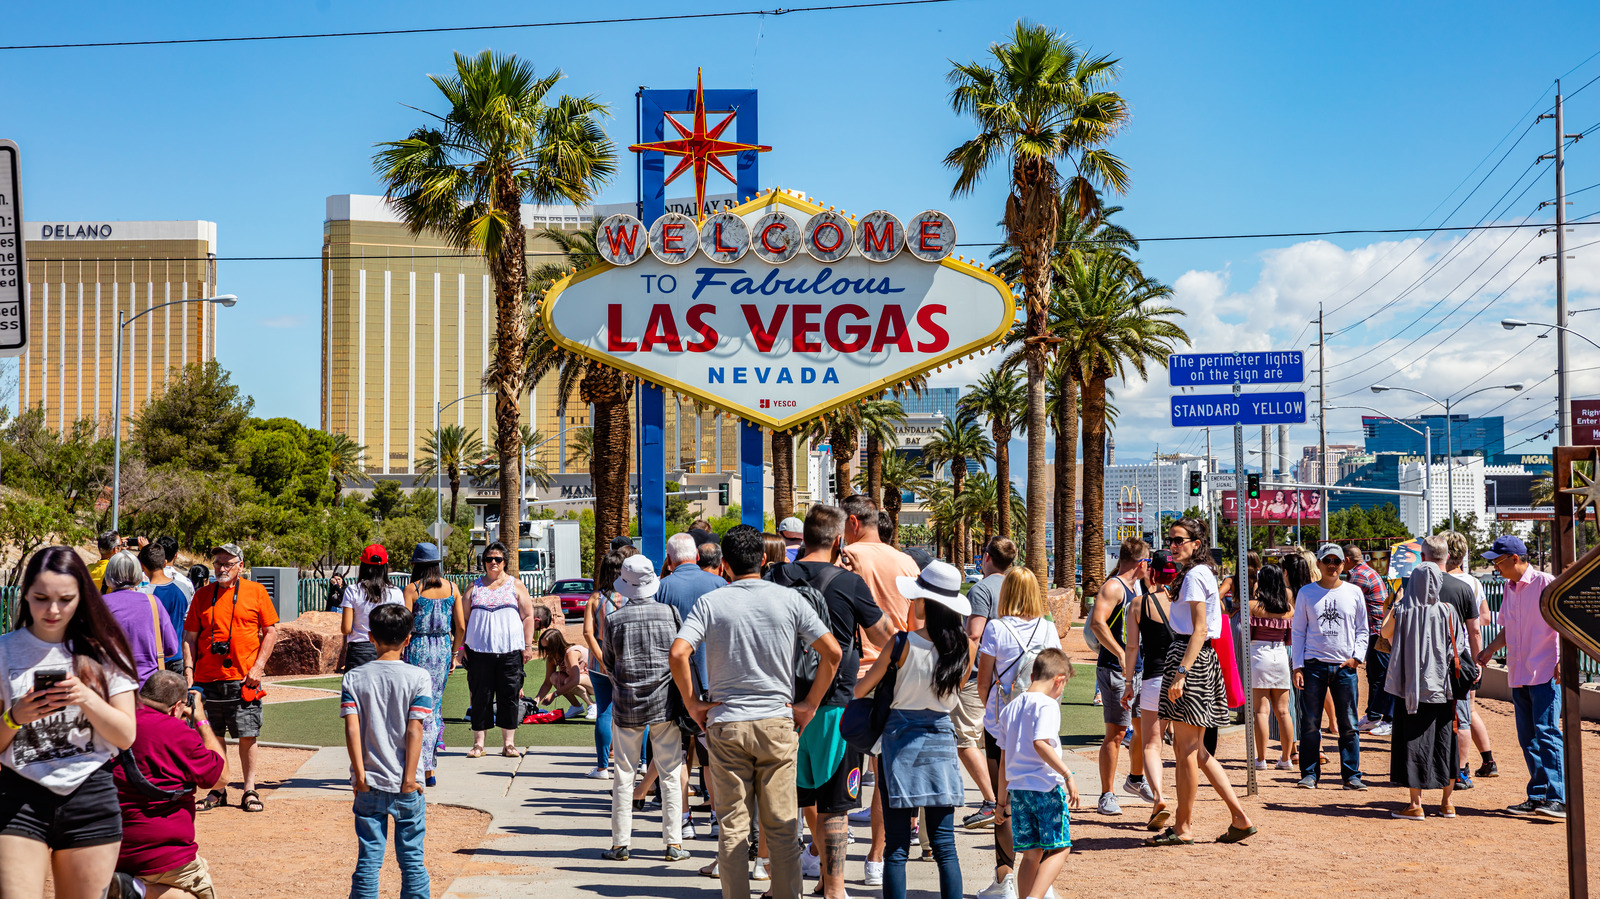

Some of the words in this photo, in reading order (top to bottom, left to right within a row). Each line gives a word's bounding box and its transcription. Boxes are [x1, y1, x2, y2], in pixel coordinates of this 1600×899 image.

[42, 224, 112, 238] DELANO
[604, 220, 943, 256] WELCOME
[641, 274, 677, 294] TO
[692, 267, 905, 300] Fabulous
[0, 304, 17, 317] ed
[607, 303, 719, 353] LAS
[741, 303, 950, 353] VEGAS
[1172, 355, 1194, 368] The
[1199, 353, 1260, 370] perimeter
[1265, 352, 1300, 368] lights
[708, 366, 840, 385] NEVADA
[1190, 371, 1205, 381] on
[1209, 369, 1229, 381] the
[1233, 368, 1259, 383] sign
[1264, 369, 1283, 379] are
[773, 400, 797, 408] YESCO
[1174, 403, 1240, 417] STANDARD
[1252, 401, 1303, 415] YELLOW
[1576, 417, 1597, 425] Enter
[1398, 455, 1425, 465] MGM
[1521, 455, 1549, 465] MGM
[1225, 496, 1259, 510] TO
